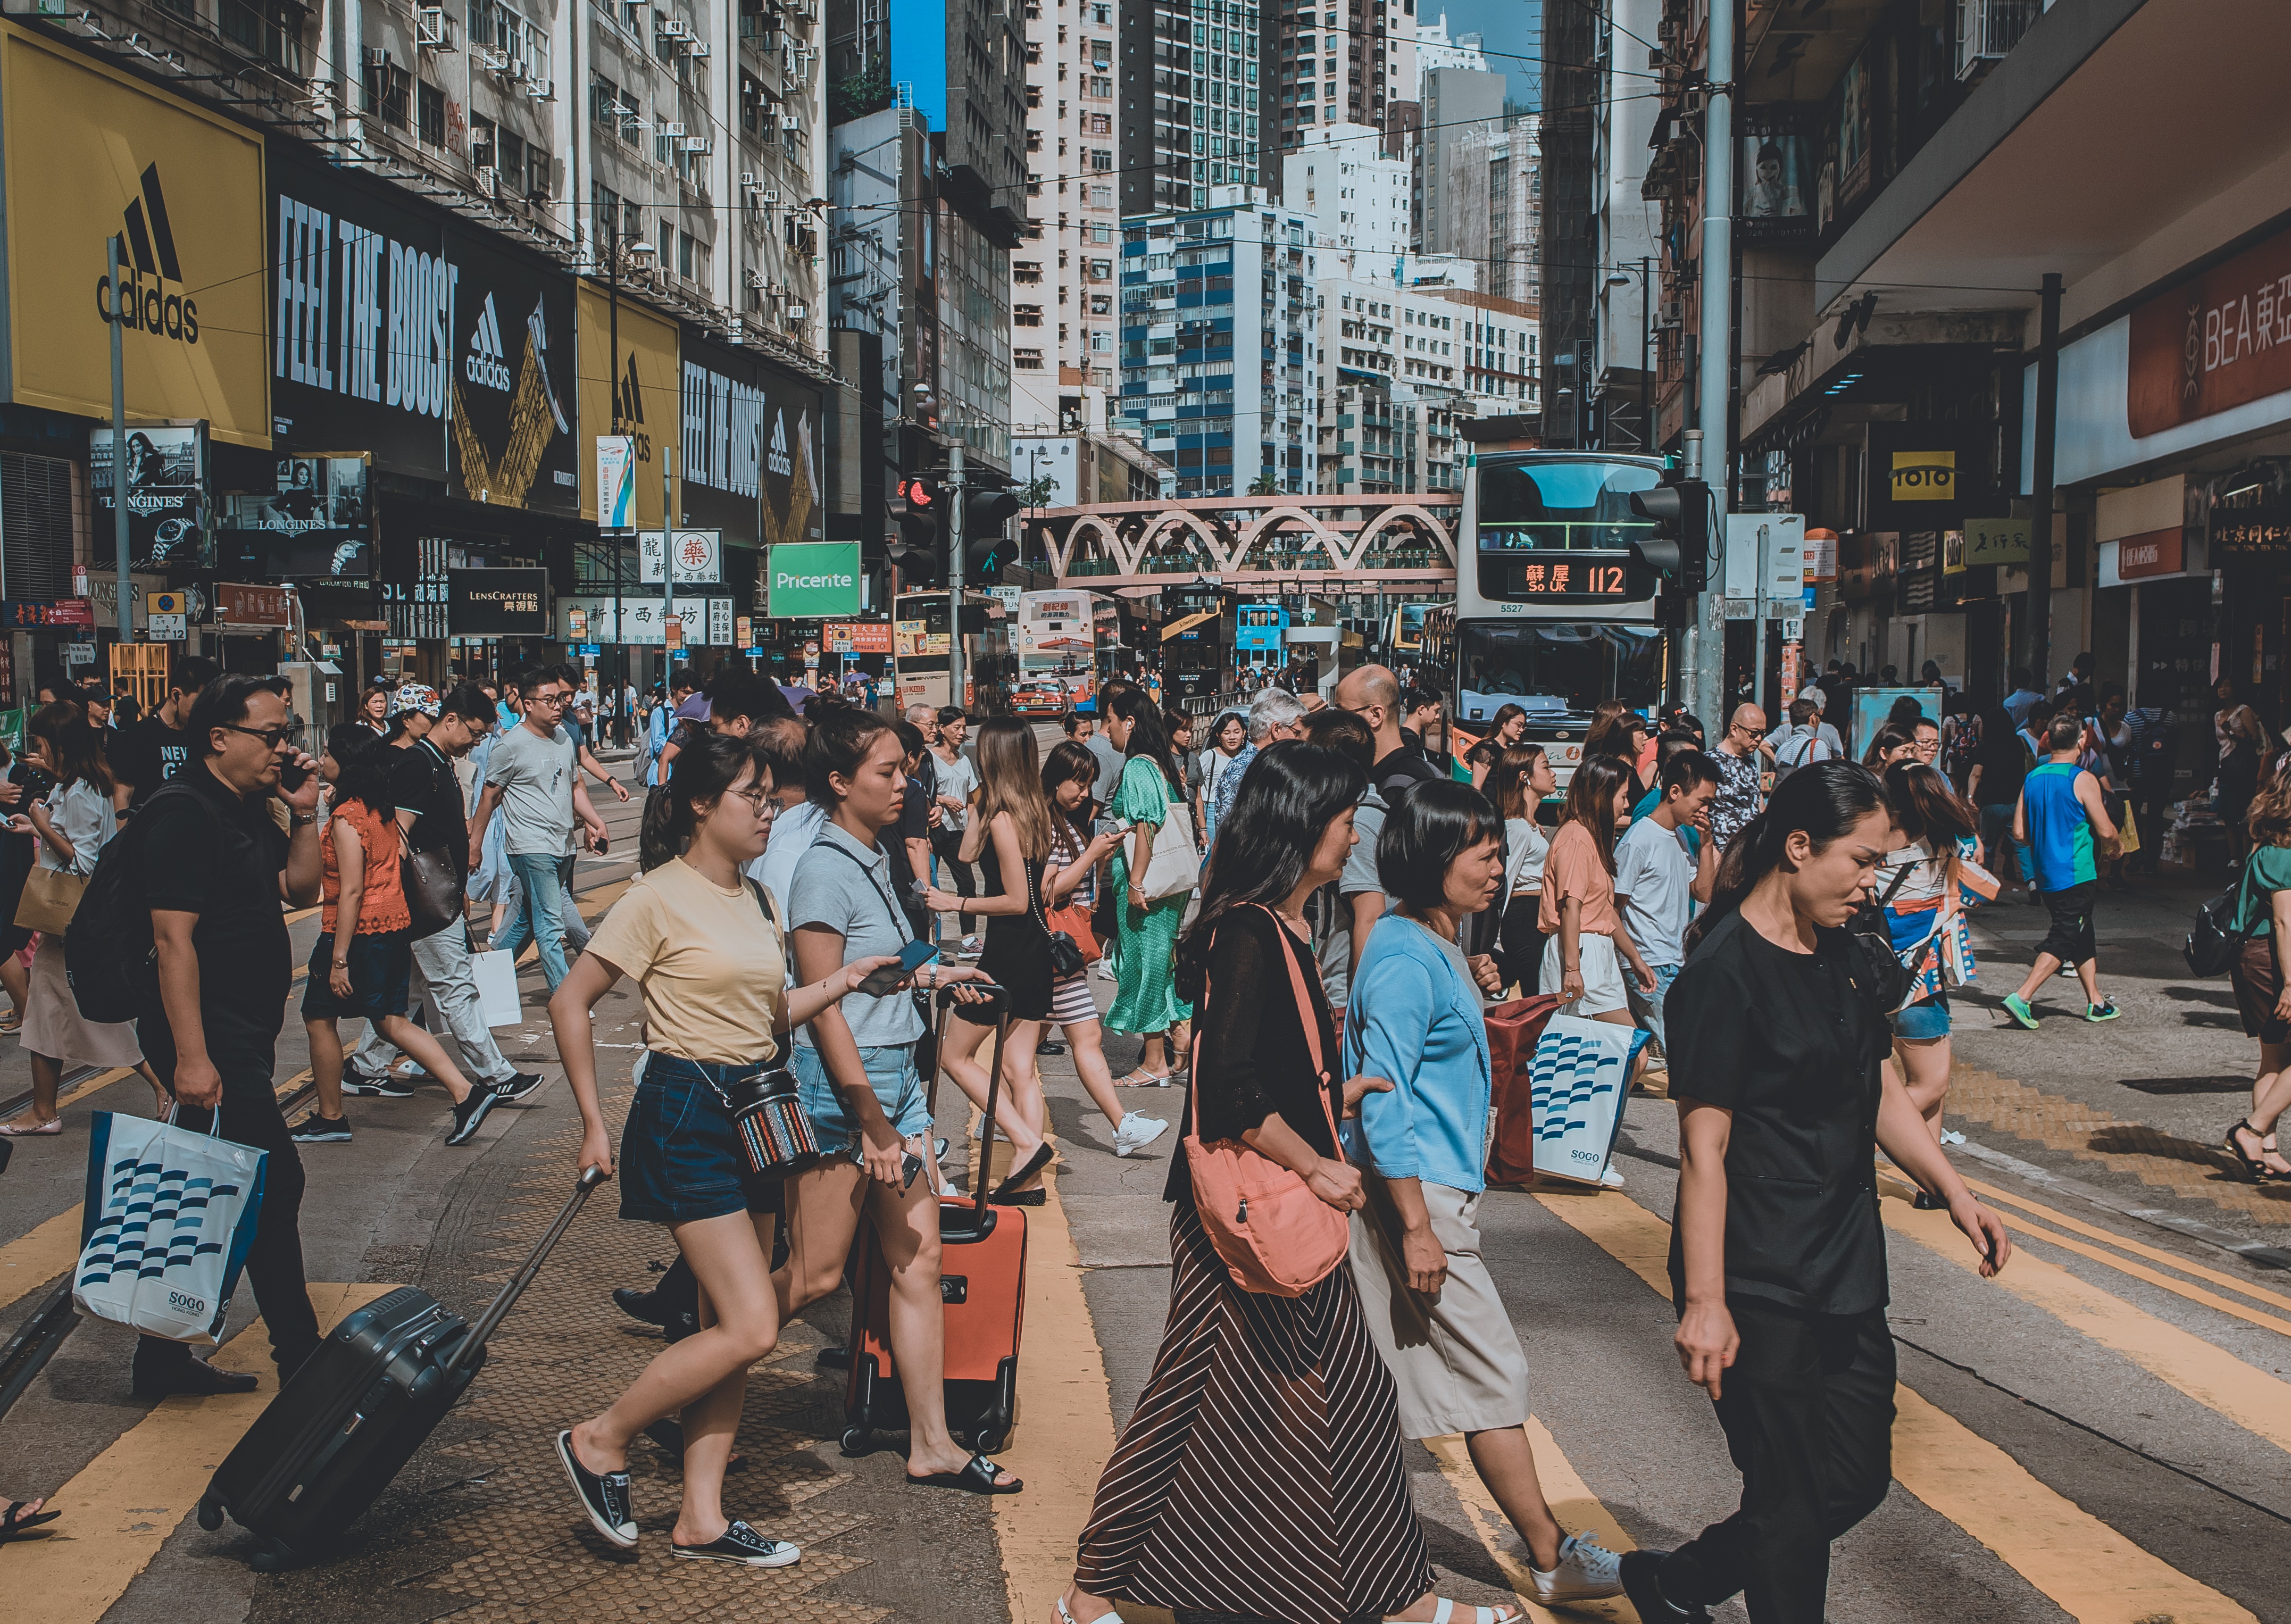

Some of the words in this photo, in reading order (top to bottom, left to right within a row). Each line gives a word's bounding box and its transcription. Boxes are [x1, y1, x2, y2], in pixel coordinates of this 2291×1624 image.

[97, 267, 198, 345] adidas
[277, 194, 332, 390] FEEL
[339, 219, 383, 402] THE
[387, 239, 458, 420] BOOST
[2205, 294, 2252, 372] BEA
[466, 345, 510, 393] adidas
[682, 360, 707, 485] FEEL
[710, 371, 730, 490] THE
[730, 380, 765, 499] BOOST
[769, 448, 790, 477] adidas
[105, 496, 184, 508] LNGINES
[259, 519, 326, 530] LONGINES
[682, 538, 707, 565] 藥
[671, 571, 719, 582] 中西藥坊
[777, 572, 852, 589] Pricerite
[1526, 564, 1569, 581] 蘇屋
[1589, 567, 1623, 593] 112
[1528, 581, 1545, 592] So
[1549, 581, 1567, 592] Uk
[504, 601, 538, 612] 亮視點
[1501, 604, 1523, 613] 5527
[171, 615, 179, 625] 7
[172, 629, 184, 639] 12
[1571, 1150, 1599, 1162] SOGO
[169, 1291, 205, 1312] SOGO
[171, 1305, 185, 1314] HONG
